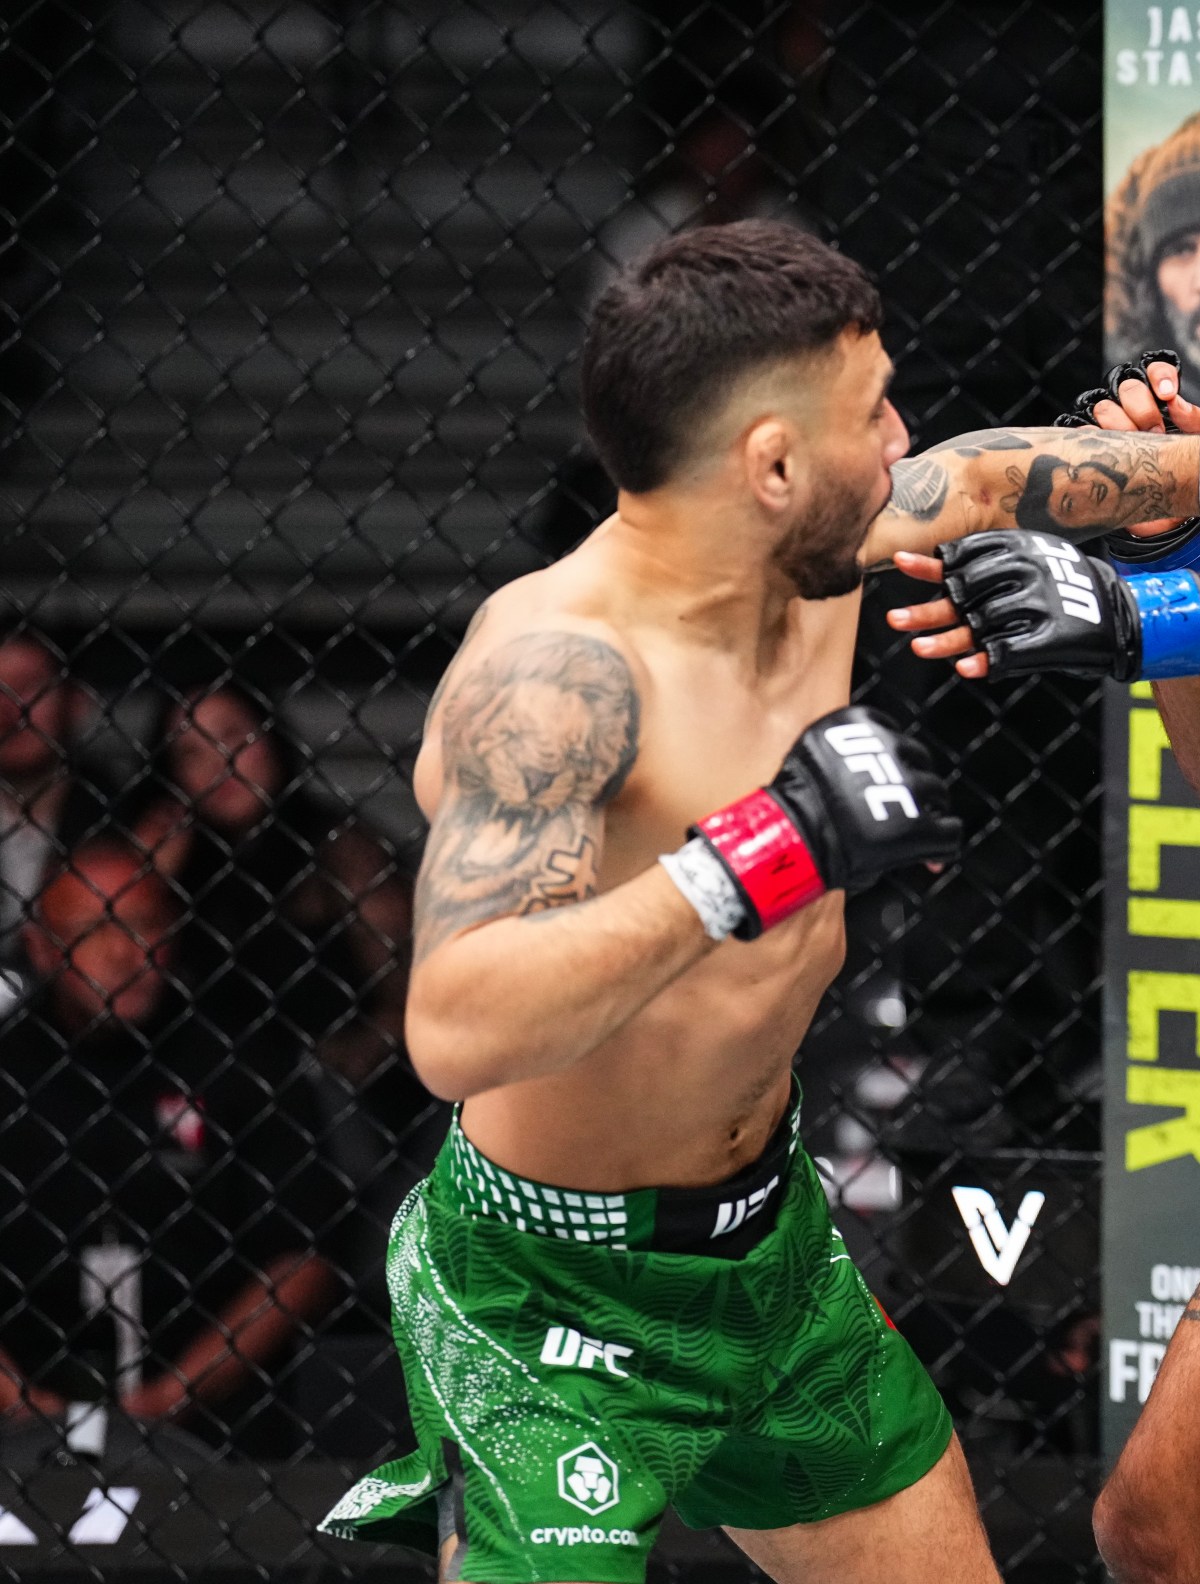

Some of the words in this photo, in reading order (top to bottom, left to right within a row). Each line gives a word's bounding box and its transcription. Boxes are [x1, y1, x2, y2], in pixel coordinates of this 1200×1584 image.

[1032, 535, 1101, 624] UFC
[824, 723, 919, 821] UFC
[540, 1327, 634, 1378] UFC
